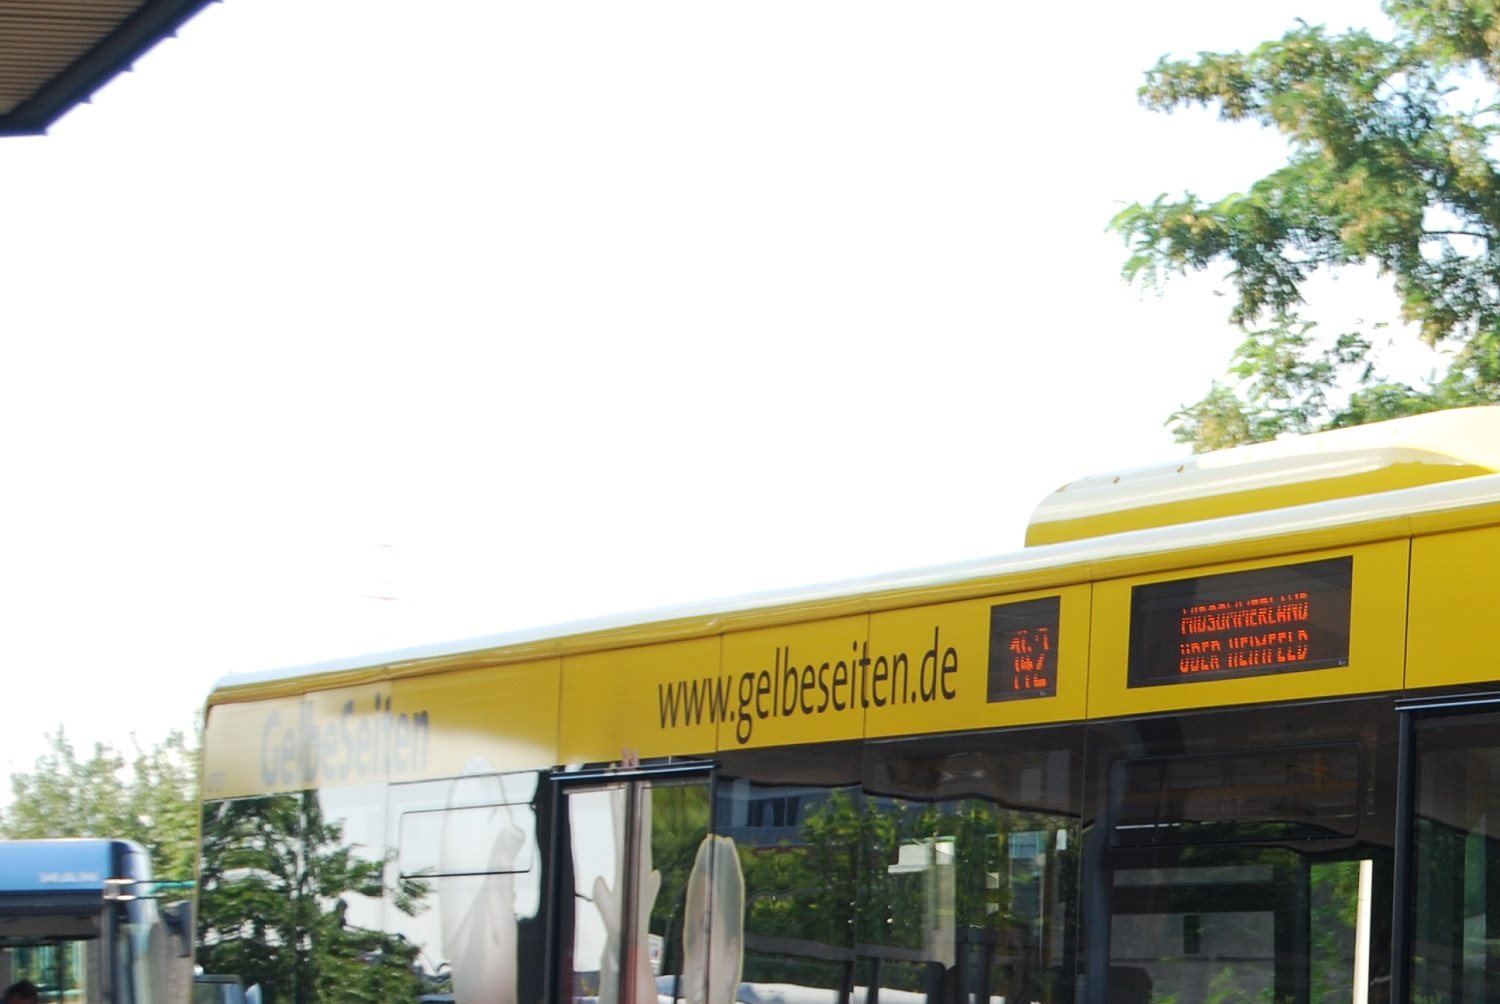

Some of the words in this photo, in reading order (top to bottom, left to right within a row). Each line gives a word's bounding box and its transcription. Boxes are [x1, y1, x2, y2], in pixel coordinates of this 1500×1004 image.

[1180, 591, 1310, 636] MIDSOMMERLAND
[657, 626, 959, 745] www.gelbeseiten.de
[1009, 626, 1051, 690] 142
[260, 692, 430, 787] GelbeSeiten
